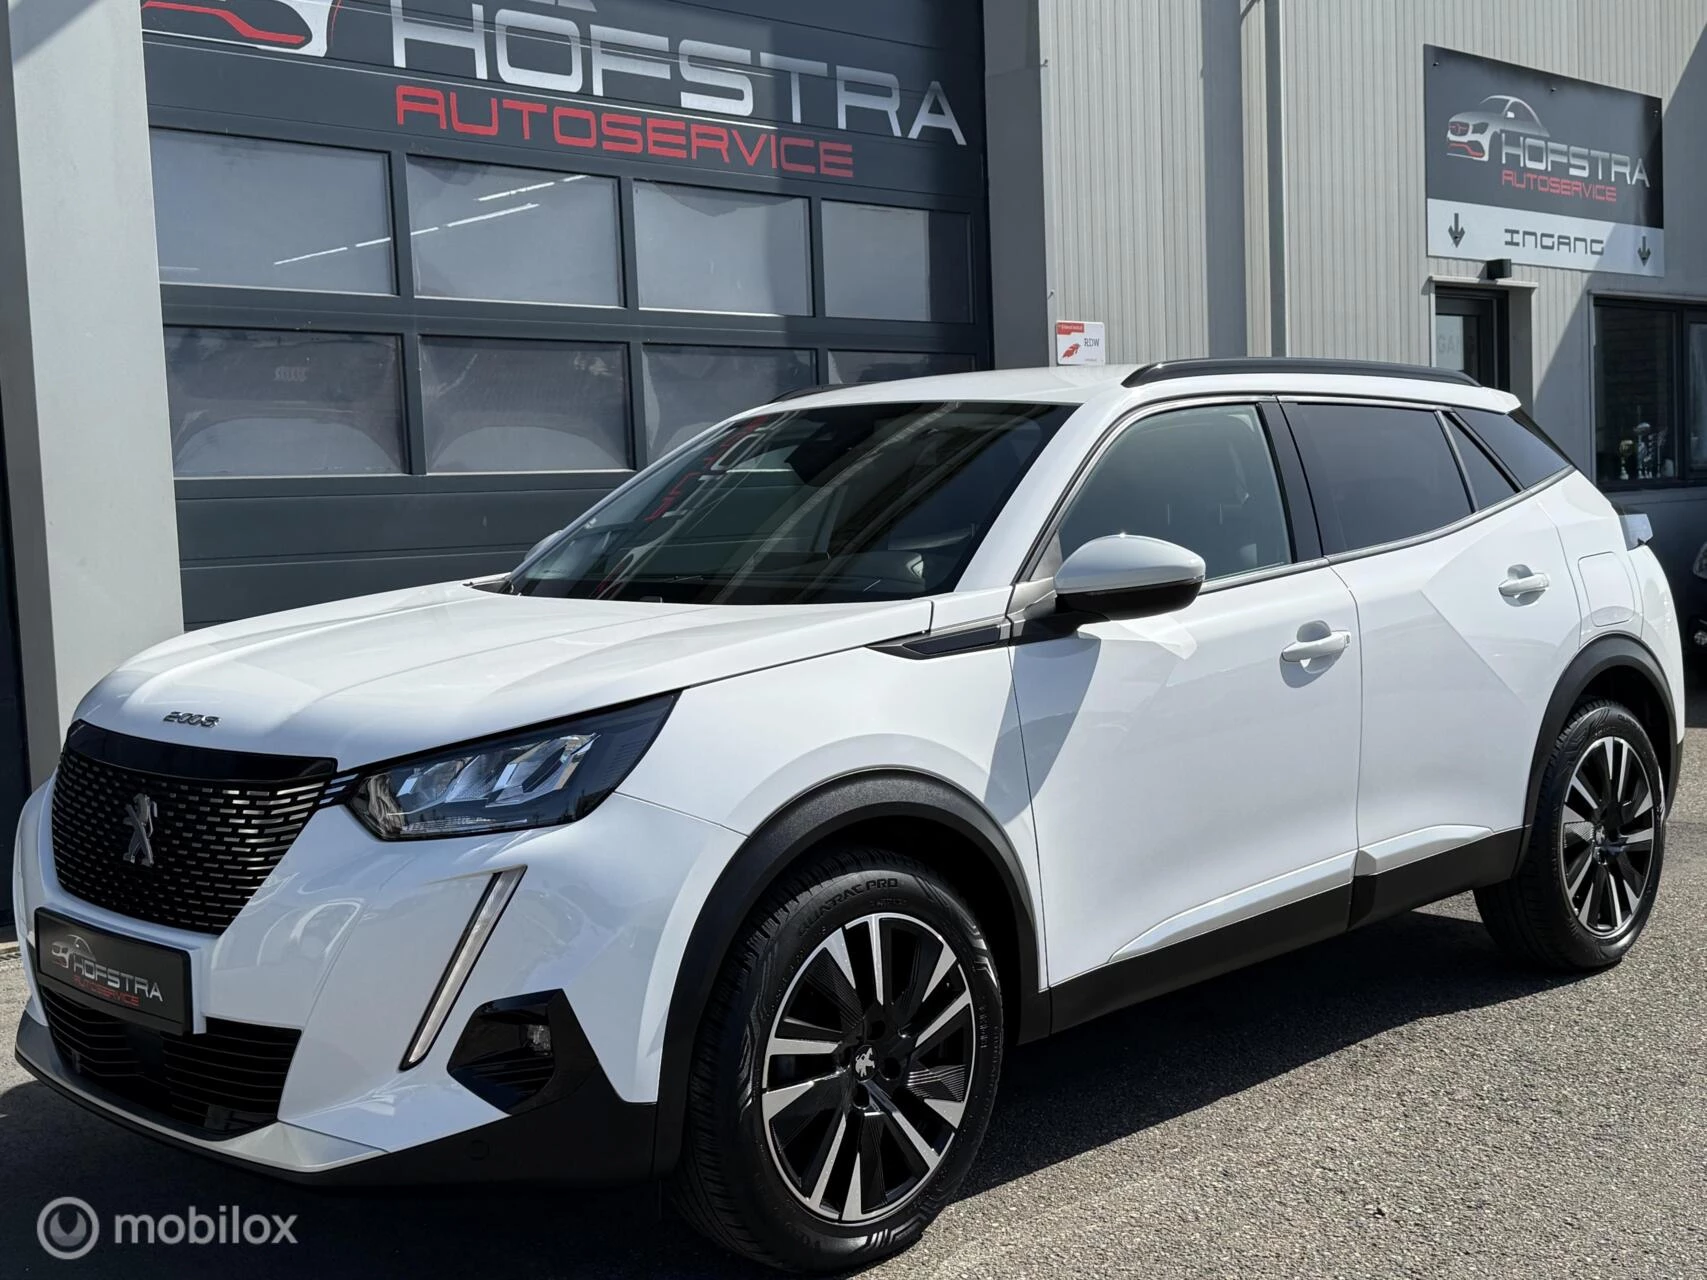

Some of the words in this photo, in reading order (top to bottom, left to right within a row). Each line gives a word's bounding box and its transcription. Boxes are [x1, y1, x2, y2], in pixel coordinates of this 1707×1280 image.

[390, 0, 967, 146] HOFSTRA
[395, 85, 855, 178] AUTOSERVICE
[1501, 132, 1650, 188] HOFSTRA
[1502, 169, 1617, 202] AUTOSERVICE
[1504, 228, 1604, 256] INGANG
[1083, 337, 1100, 347] RDW
[162, 711, 219, 729] 2008
[865, 878, 898, 890] PRO
[72, 976, 140, 1007] AUTOSERVICE
[73, 953, 163, 1002] HOFSTRA
